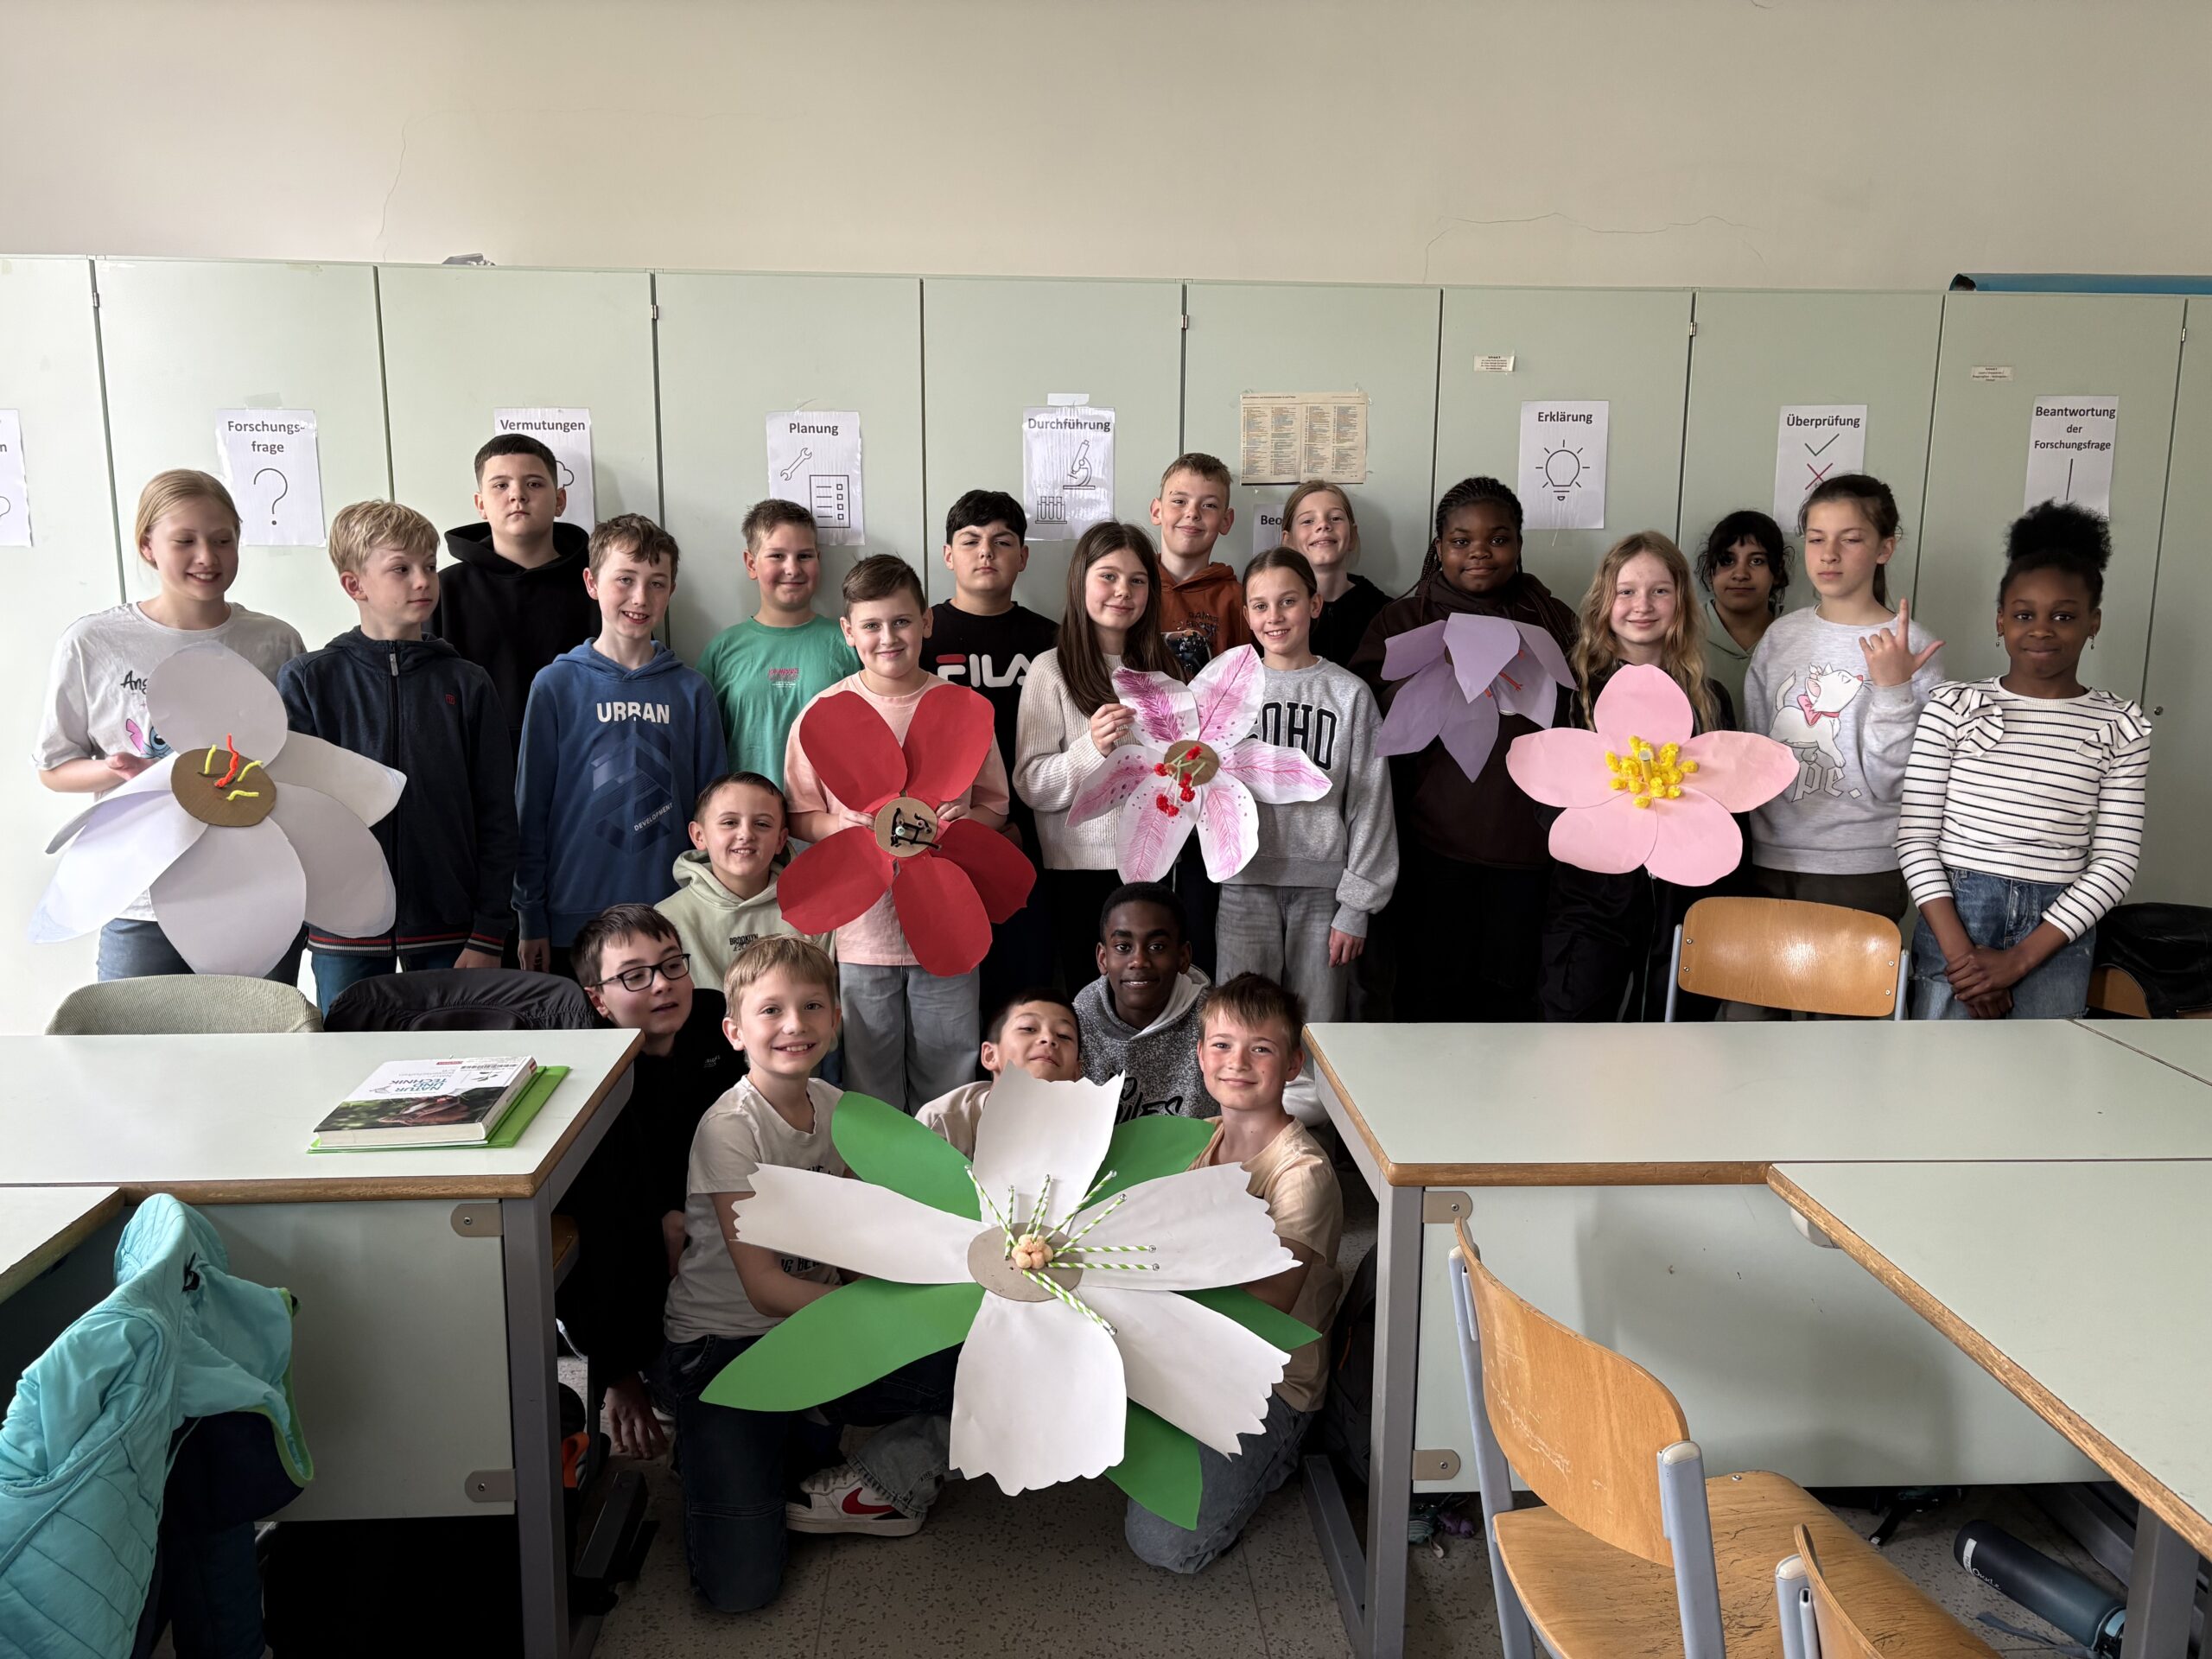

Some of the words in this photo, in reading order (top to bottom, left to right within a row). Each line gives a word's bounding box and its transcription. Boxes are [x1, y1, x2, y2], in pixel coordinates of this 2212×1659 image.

[1538, 411, 1593, 424] Erklärung
[2036, 406, 2116, 419] Beantwortung
[227, 421, 305, 435] Forschungs-
[499, 419, 586, 433] Vermutungen
[1028, 417, 1111, 433] Durchführung
[1787, 413, 1860, 429] Überprüfung
[2066, 423, 2083, 433] der
[789, 422, 839, 436] Planung
[251, 441, 284, 454] frage
[2034, 439, 2112, 451] Forschungsfrage
[1261, 514, 1283, 525] Beo
[936, 652, 1032, 688] FILA
[119, 670, 148, 696] Ang
[596, 702, 670, 724] URBAN
[1246, 701, 1338, 771] OHO
[1791, 760, 1863, 803] pe.
[633, 802, 673, 831] DEVELOPMENT
